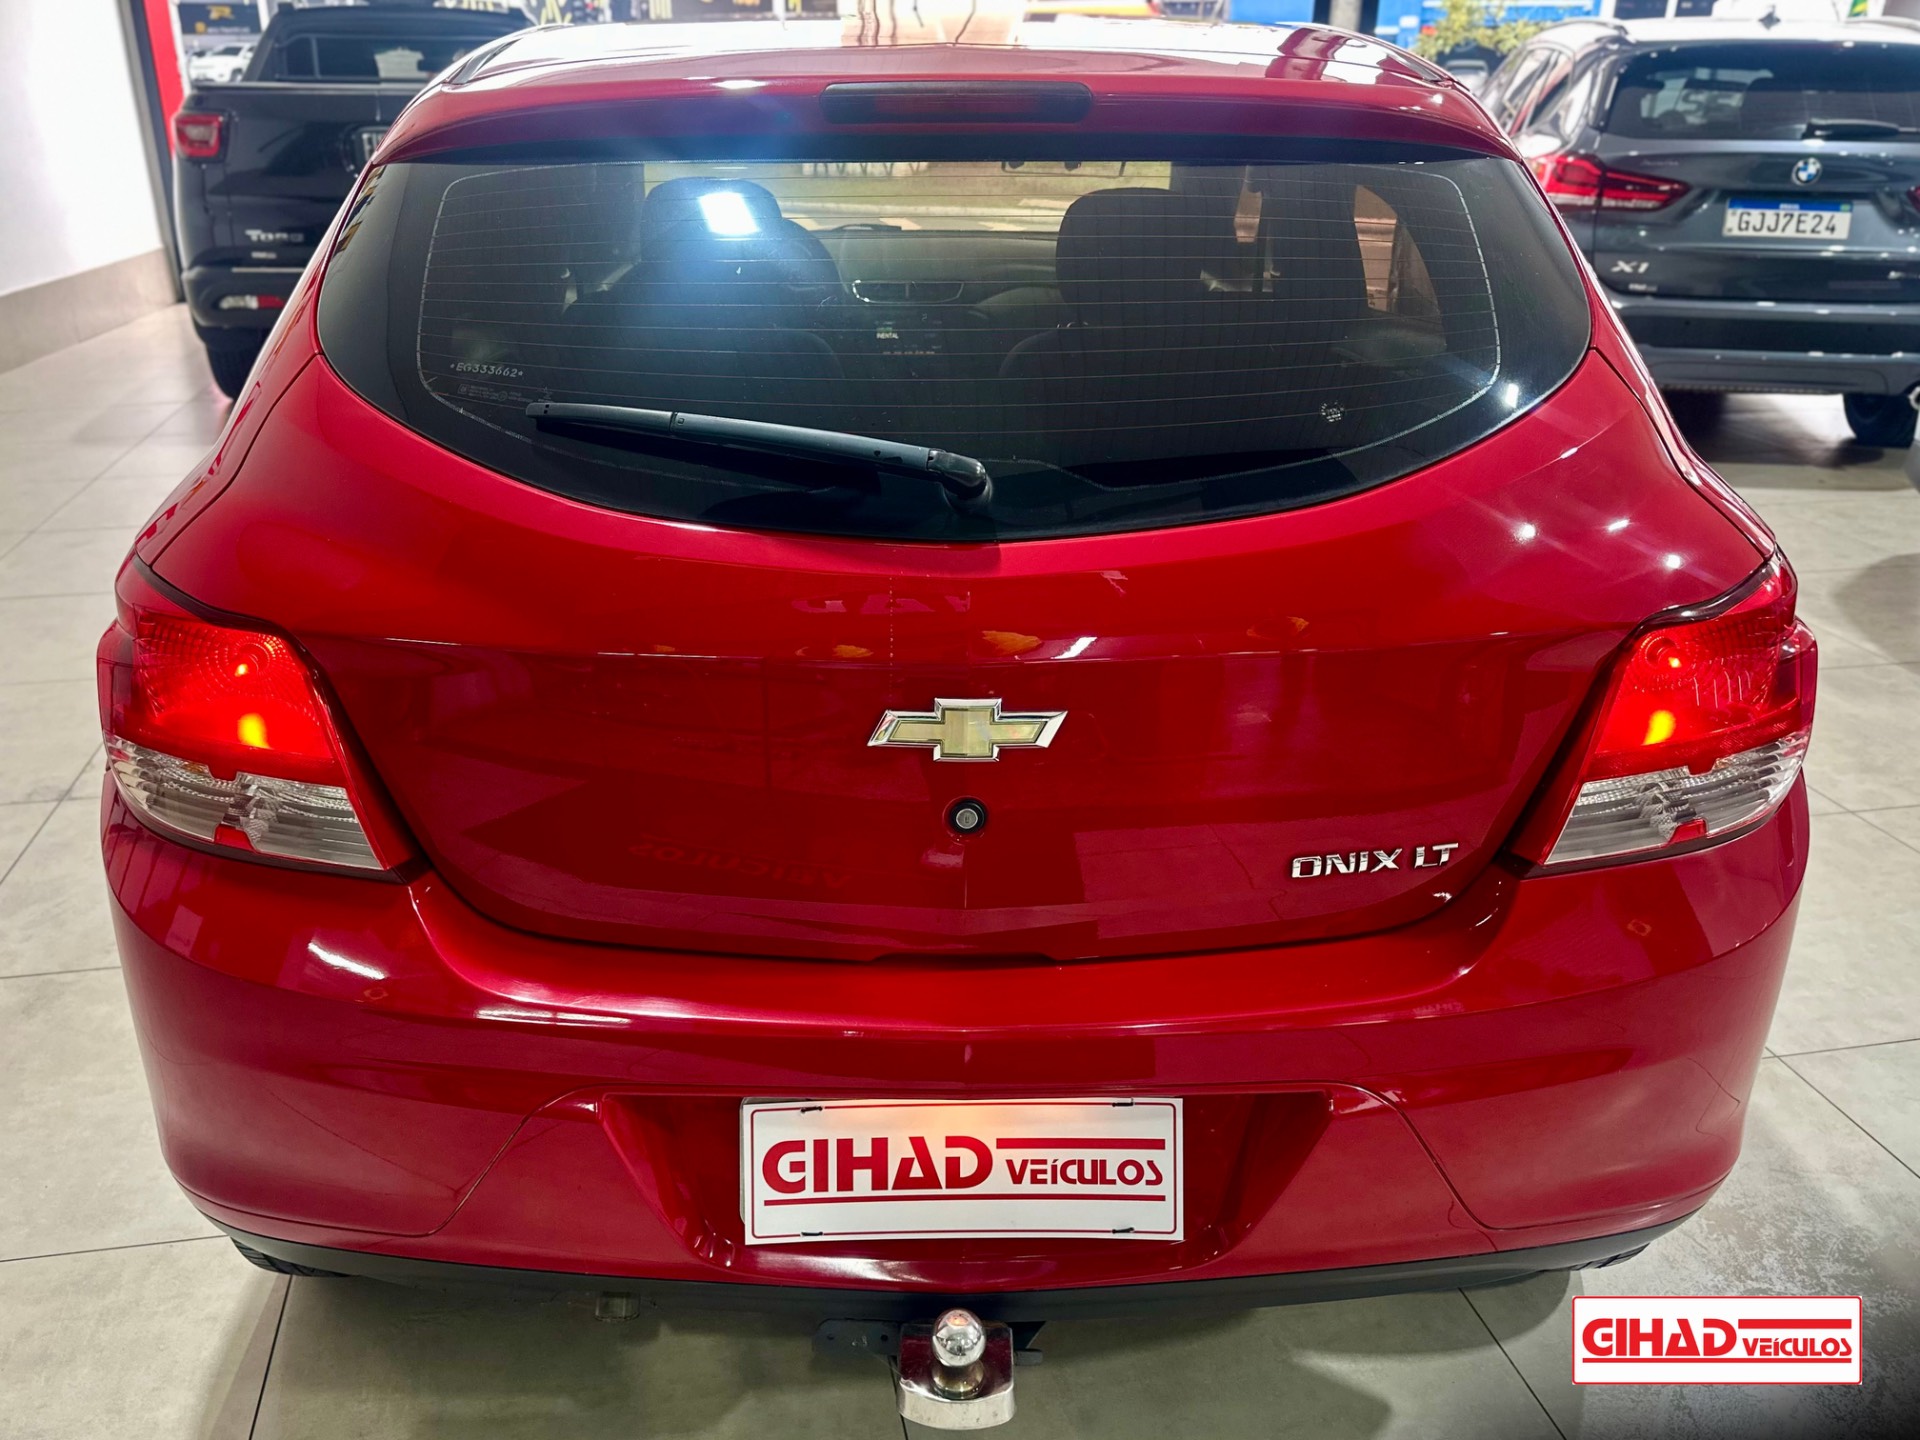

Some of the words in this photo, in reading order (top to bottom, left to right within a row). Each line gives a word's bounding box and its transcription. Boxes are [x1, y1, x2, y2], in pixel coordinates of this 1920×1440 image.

[1737, 211, 1837, 235] GJJ7E24
[1611, 260, 1649, 273] X1
[1291, 848, 1403, 878] ONIX
[1414, 842, 1459, 868] LT
[761, 1135, 994, 1194] GIHAD
[1005, 1158, 1164, 1187] VEÍCULOS
